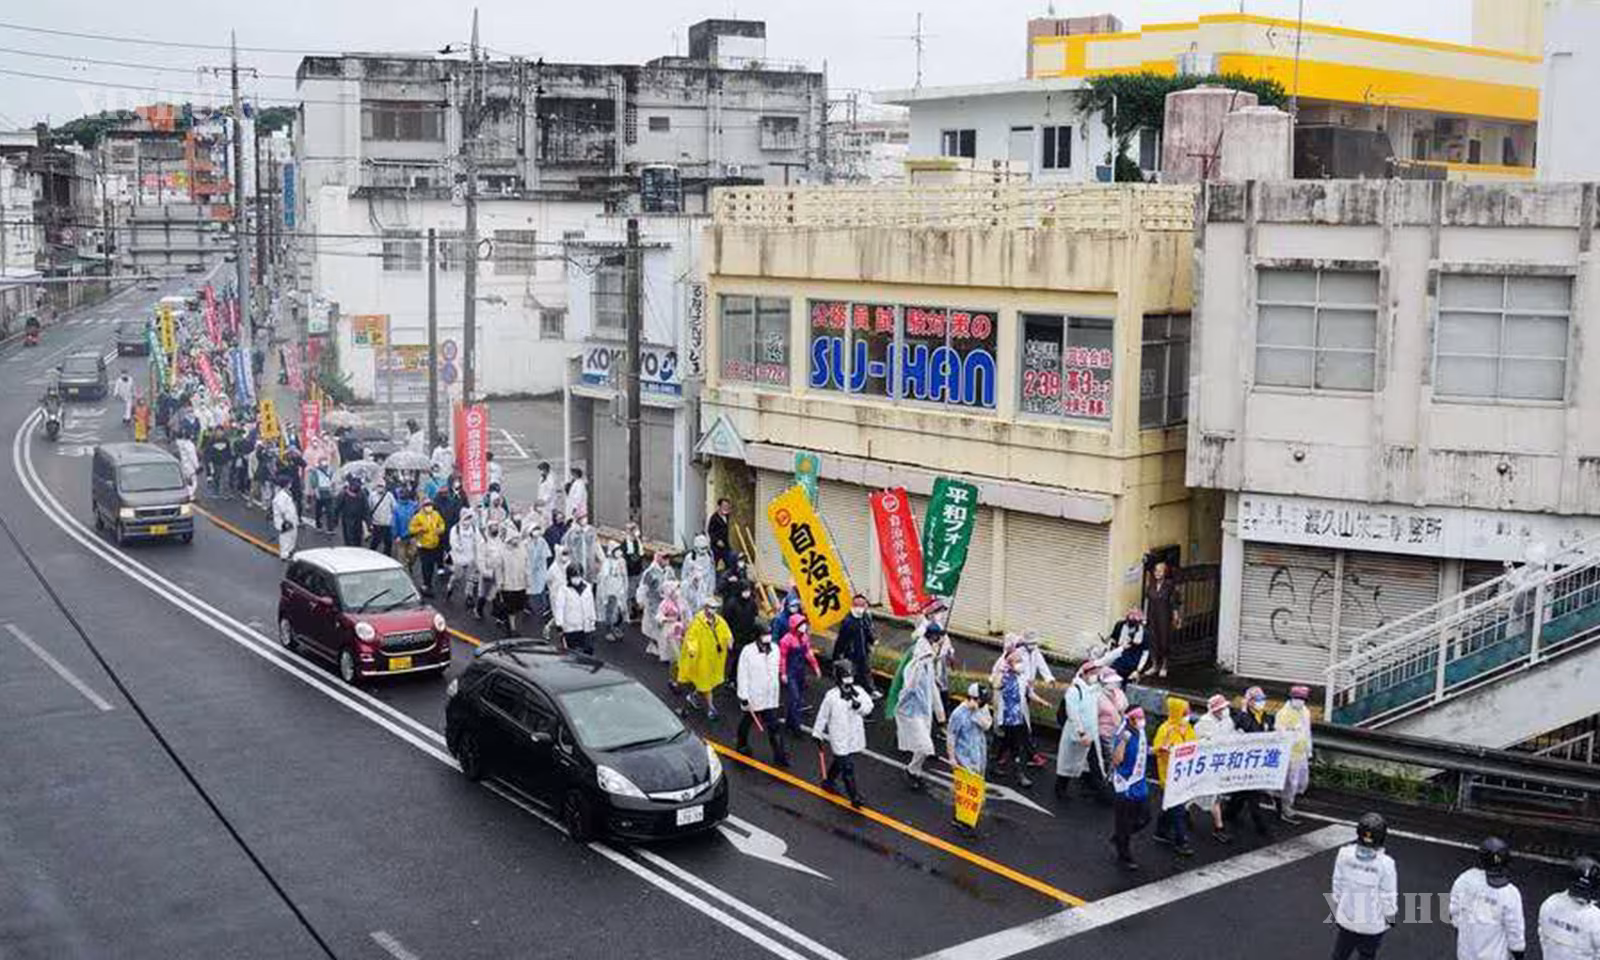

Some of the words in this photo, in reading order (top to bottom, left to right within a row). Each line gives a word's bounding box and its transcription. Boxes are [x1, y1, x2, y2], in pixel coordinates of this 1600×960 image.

[809, 335, 997, 407] SU-HAN
[788, 522, 842, 617] 自治労
[925, 486, 970, 592] 平和フォーラム
[1209, 748, 1281, 773] 平和行進
